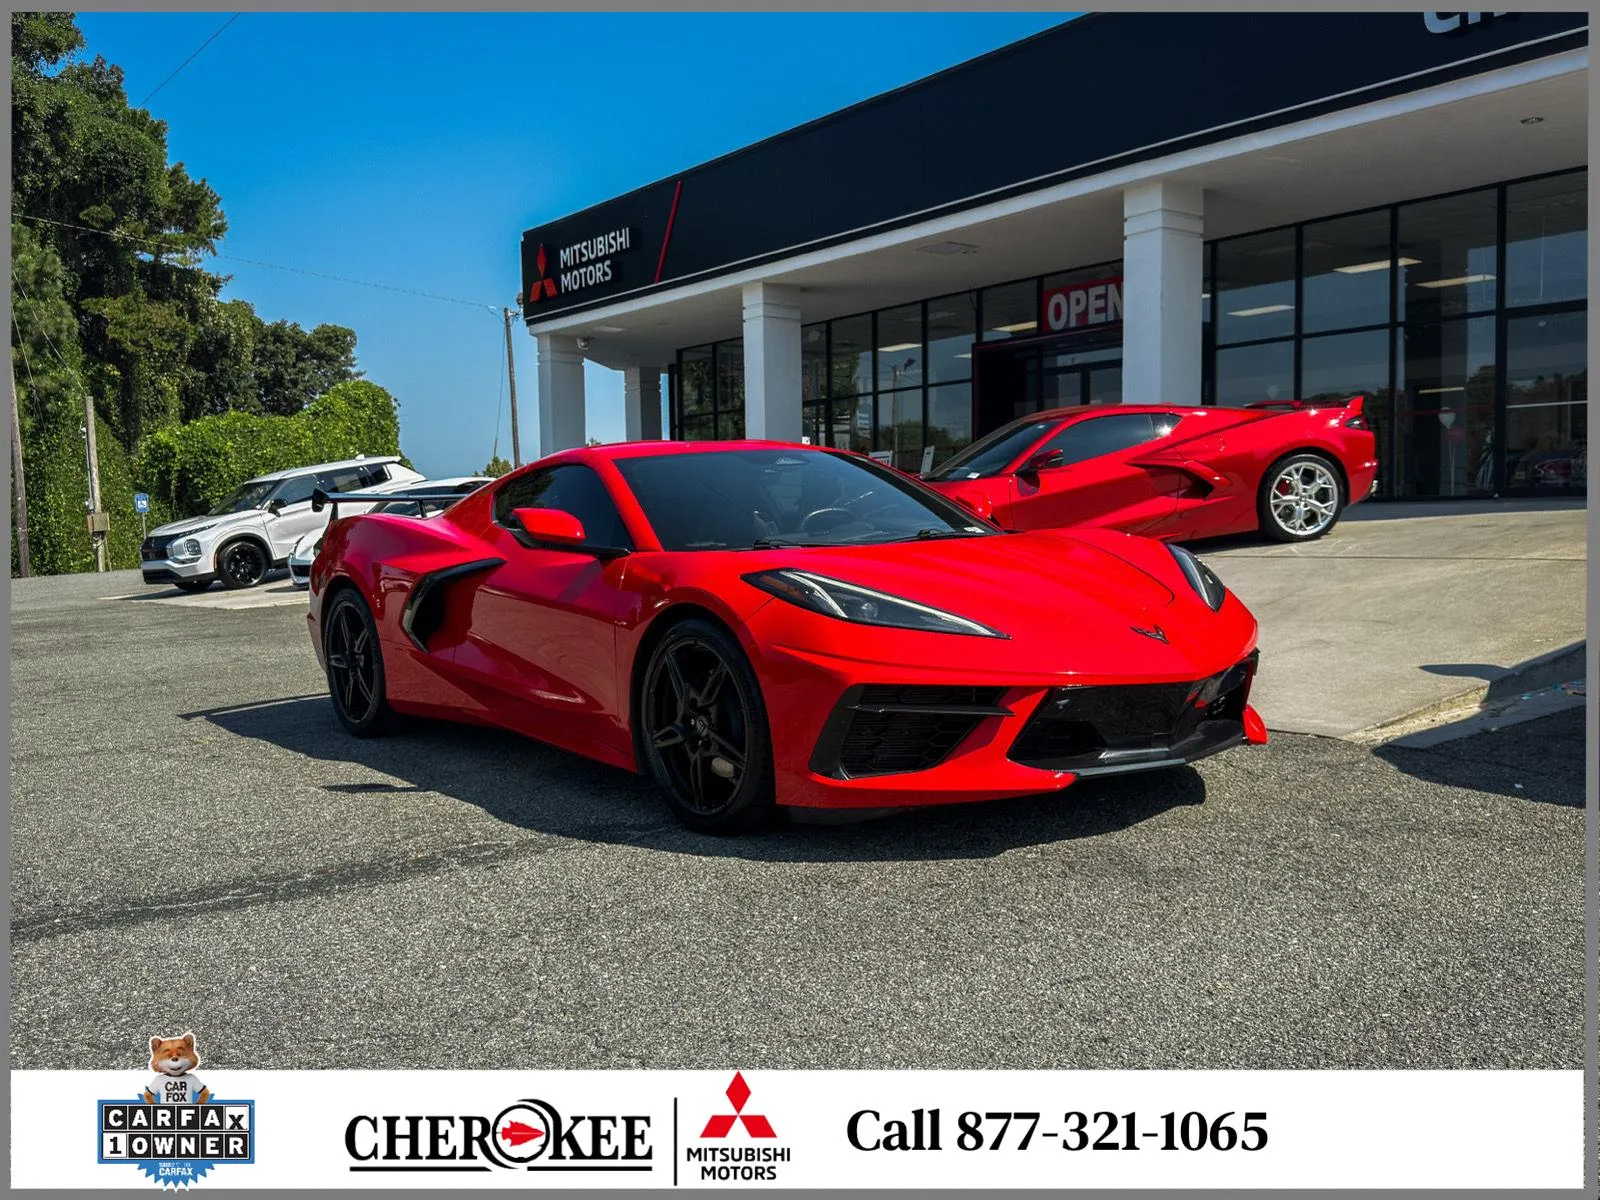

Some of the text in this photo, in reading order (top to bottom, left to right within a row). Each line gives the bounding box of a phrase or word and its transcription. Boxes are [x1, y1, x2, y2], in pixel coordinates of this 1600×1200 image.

[560, 227, 630, 268] MITSUBISHI
[561, 260, 612, 293] MOTORS
[1048, 283, 1123, 330] OPEN
